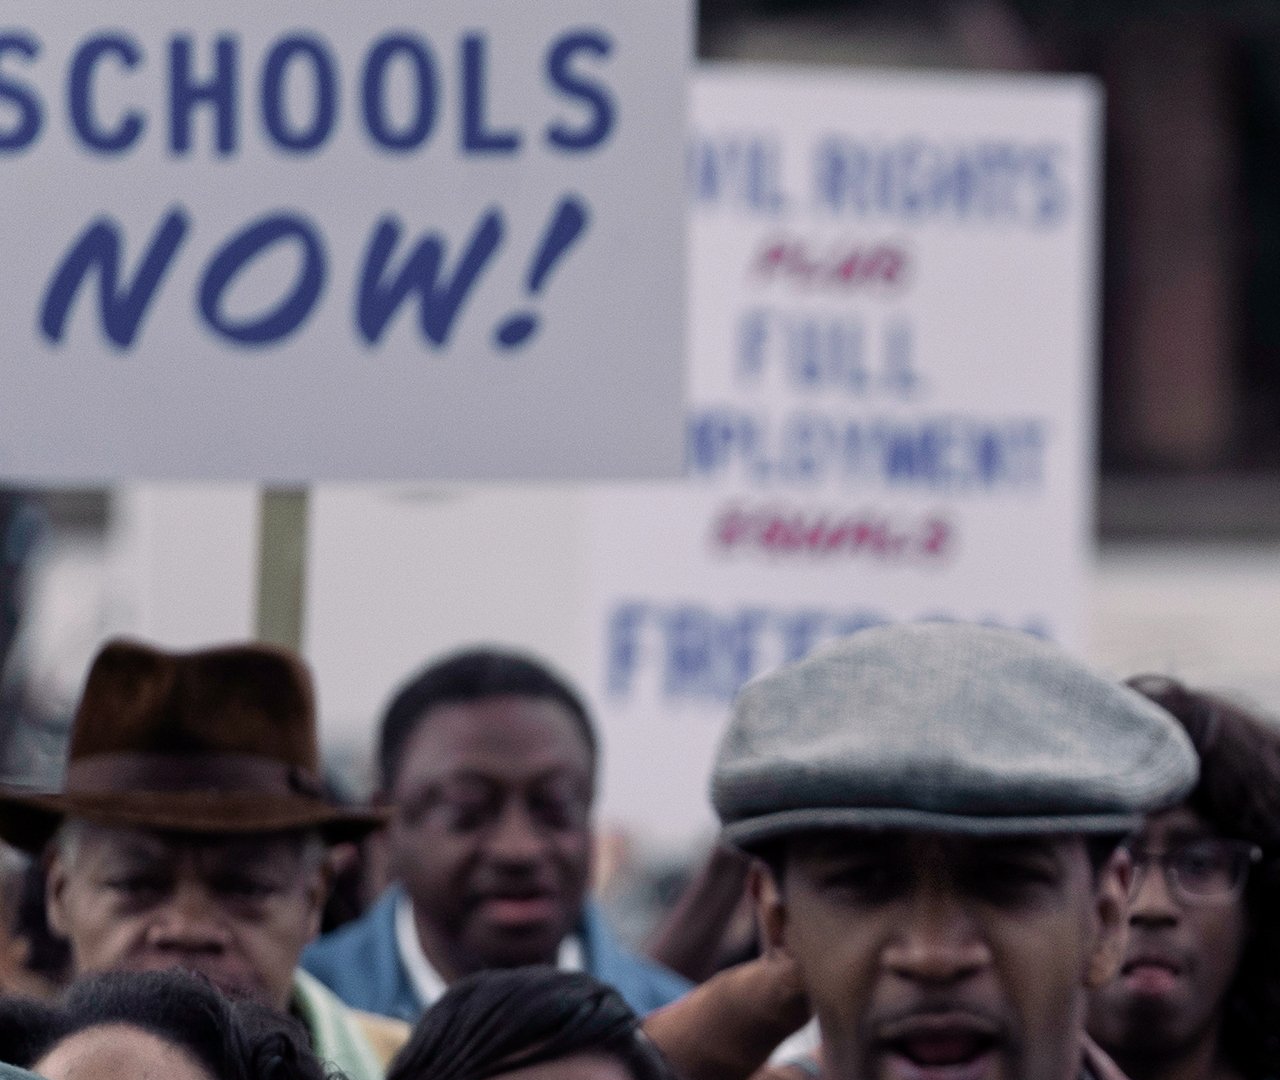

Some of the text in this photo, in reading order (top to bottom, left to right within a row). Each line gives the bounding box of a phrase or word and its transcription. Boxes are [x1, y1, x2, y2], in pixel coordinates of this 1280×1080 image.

[0, 31, 617, 157] SCHOOLS
[816, 140, 1068, 226] RIGHTS
[39, 195, 589, 351] NOW!
[740, 310, 924, 394] FULL
